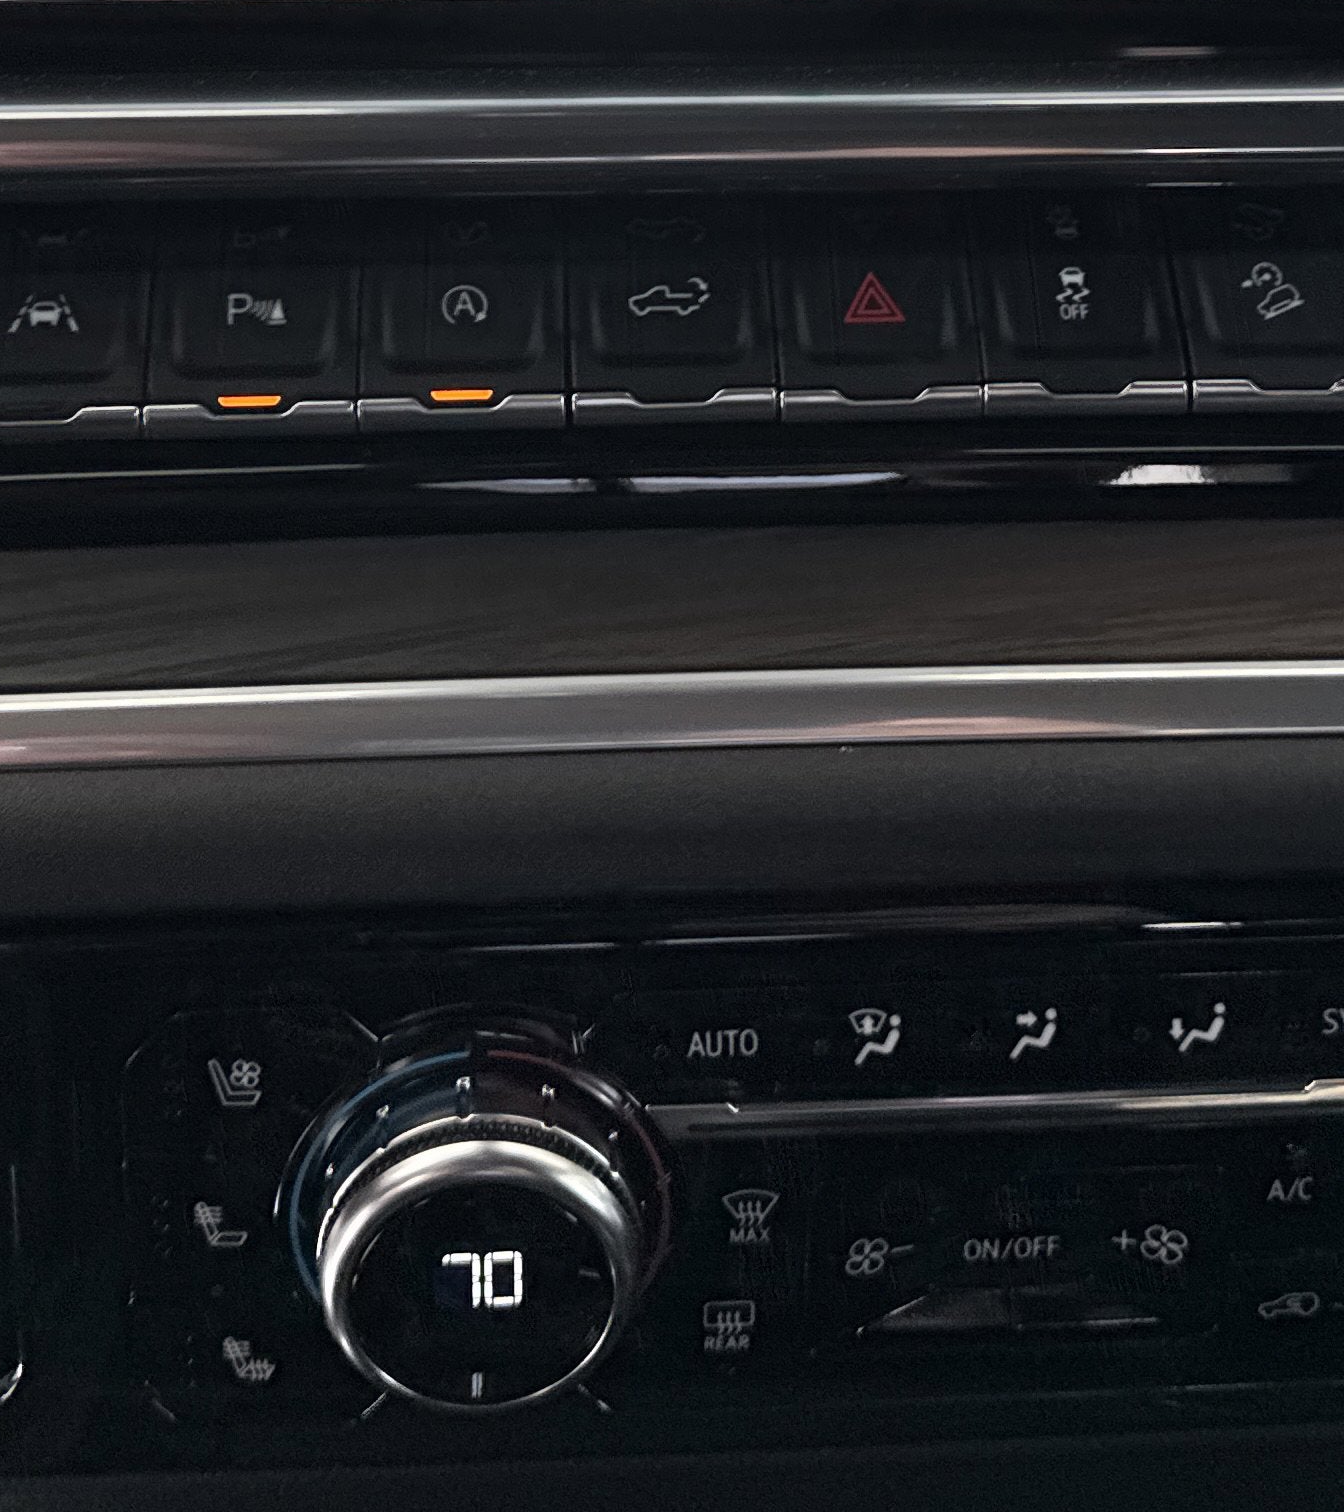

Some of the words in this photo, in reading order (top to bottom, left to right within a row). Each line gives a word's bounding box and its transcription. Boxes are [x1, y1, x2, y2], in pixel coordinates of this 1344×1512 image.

[1059, 303, 1090, 321] OFF
[687, 1030, 758, 1059] AUTO
[1266, 1176, 1315, 1202] A/C
[729, 1224, 771, 1244] MAX
[963, 1234, 1061, 1262] ON/OFF
[440, 1249, 524, 1309] 70
[704, 1332, 751, 1351] REAR
